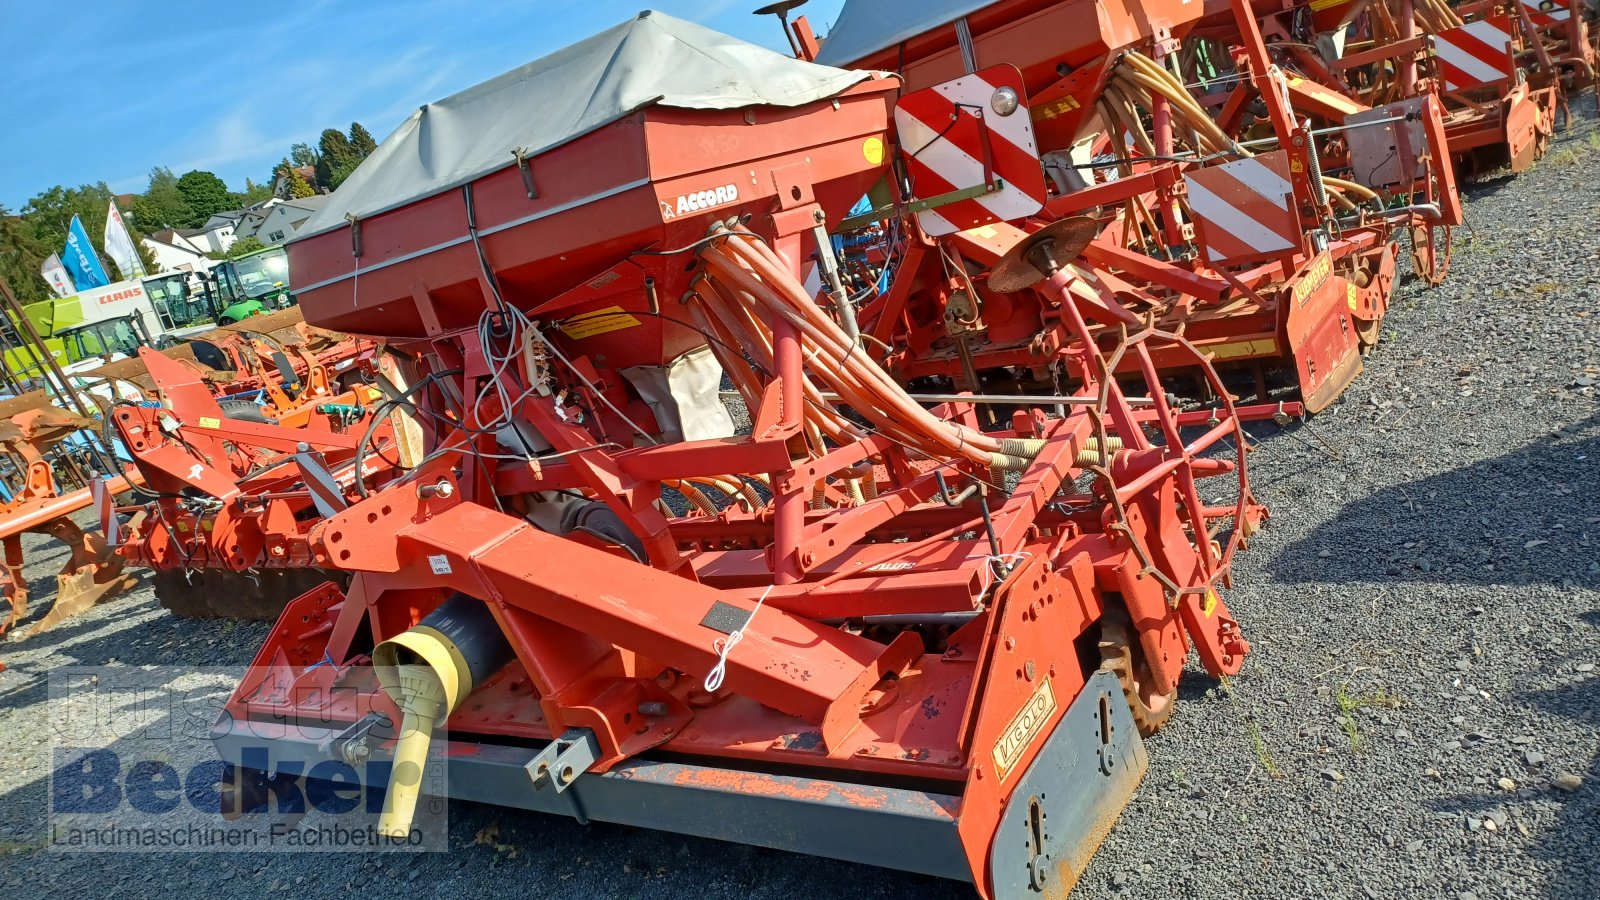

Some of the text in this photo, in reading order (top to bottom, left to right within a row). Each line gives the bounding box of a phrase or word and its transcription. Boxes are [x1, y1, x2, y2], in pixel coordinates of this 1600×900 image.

[676, 184, 738, 215] ACCORD
[99, 288, 142, 304] CLAAS
[1000, 694, 1046, 764] VIGOLO
